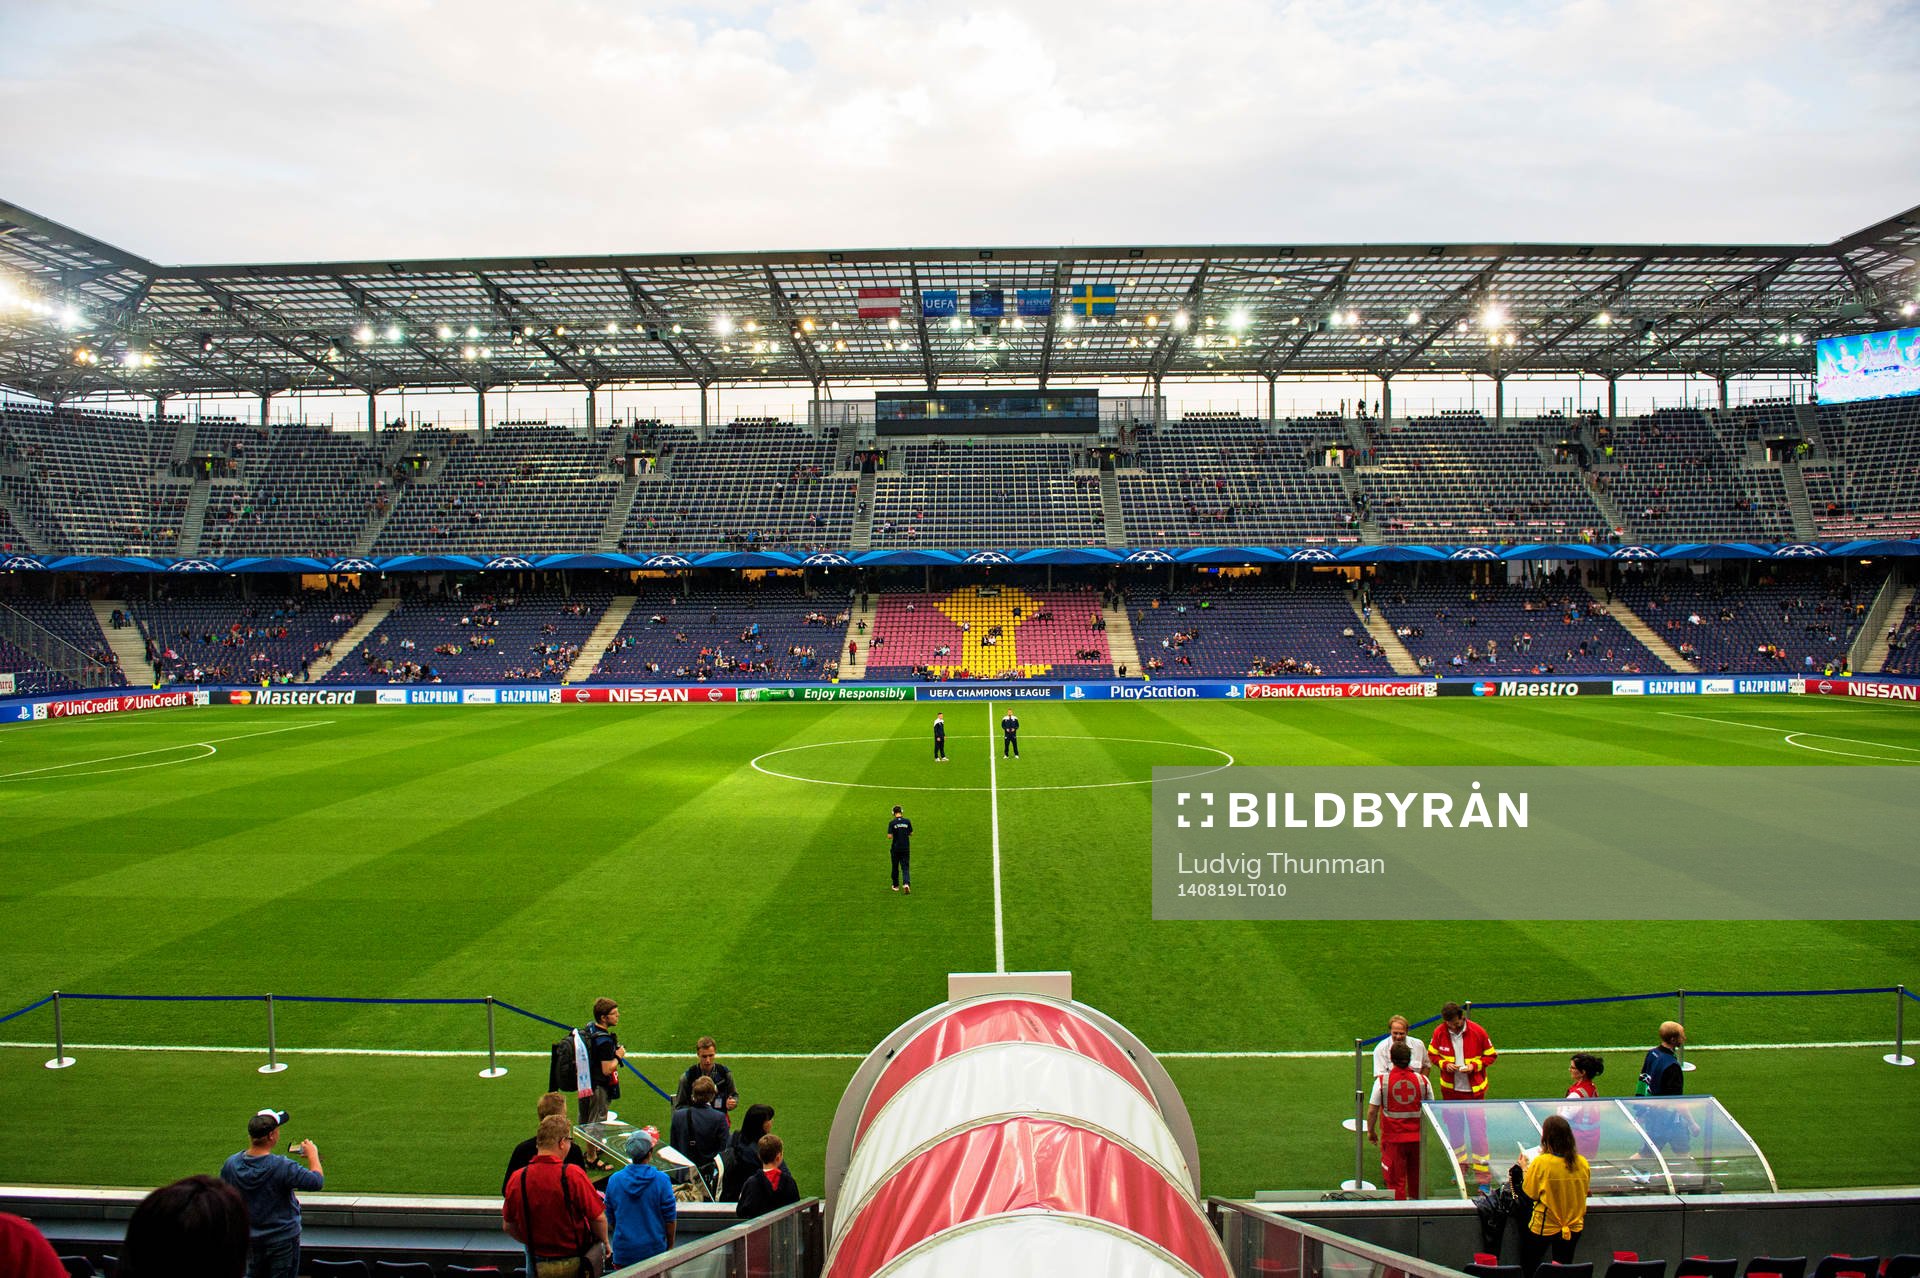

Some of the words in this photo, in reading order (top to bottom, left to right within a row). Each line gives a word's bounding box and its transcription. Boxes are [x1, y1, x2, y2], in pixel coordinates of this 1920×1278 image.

[925, 299, 955, 309] UEFA
[929, 689, 954, 697] UEFA
[956, 689, 1012, 697] CHAMPIONS
[1015, 688, 1051, 697] LEAGUE
[1261, 684, 1296, 697] Bank
[1297, 684, 1343, 697] Austria
[1362, 683, 1424, 697] UniCredit
[1500, 681, 1579, 696] Maestro
[1649, 681, 1696, 694] GAZPROM
[1739, 680, 1786, 693] GAZPROM
[1848, 682, 1917, 700] NISSAN
[255, 690, 356, 704] MasterCard
[411, 690, 458, 703] GAZPROM
[501, 690, 548, 702] GAZPROM
[608, 689, 689, 702] NISSAN
[804, 688, 836, 700] Enjoy
[838, 688, 907, 700] Responsibly
[66, 699, 119, 716] UniCredit
[135, 693, 187, 709] UniCredit
